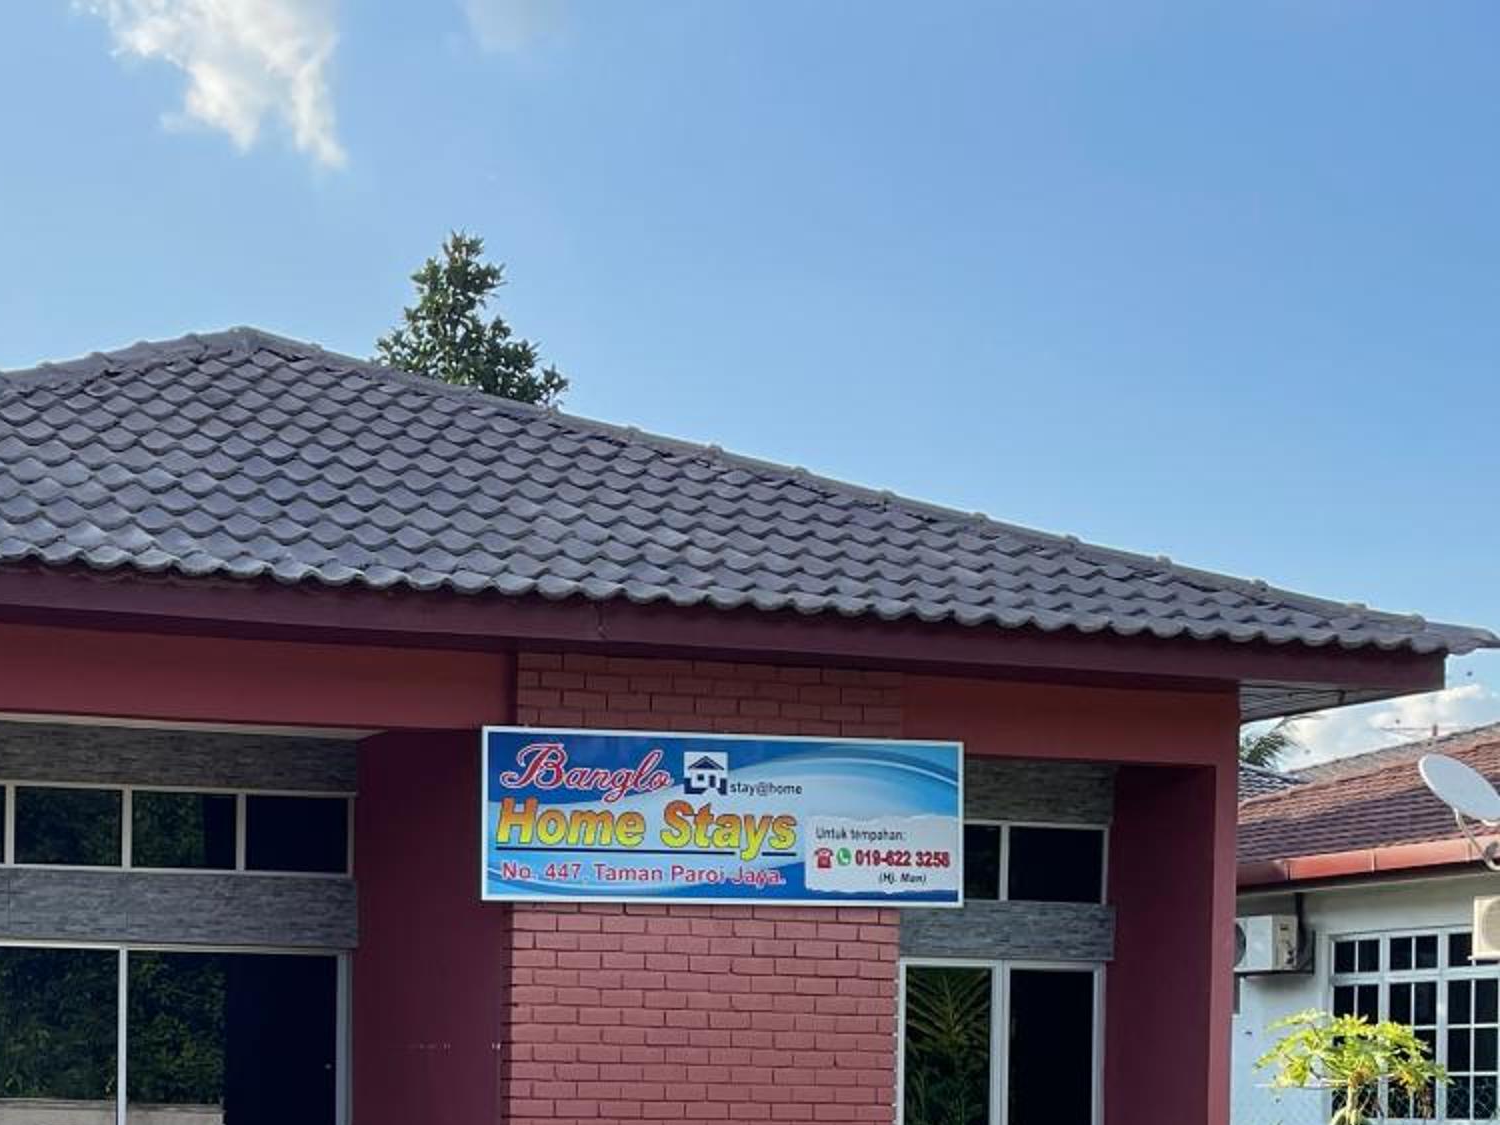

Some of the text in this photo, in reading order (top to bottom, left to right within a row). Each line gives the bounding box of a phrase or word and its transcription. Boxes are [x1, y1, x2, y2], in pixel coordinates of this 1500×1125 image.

[501, 743, 674, 802] Banglo
[496, 797, 797, 861] Home Stays
[815, 826, 847, 840] Untuk
[594, 864, 662, 882] Taman
[670, 865, 724, 883] Paroi
